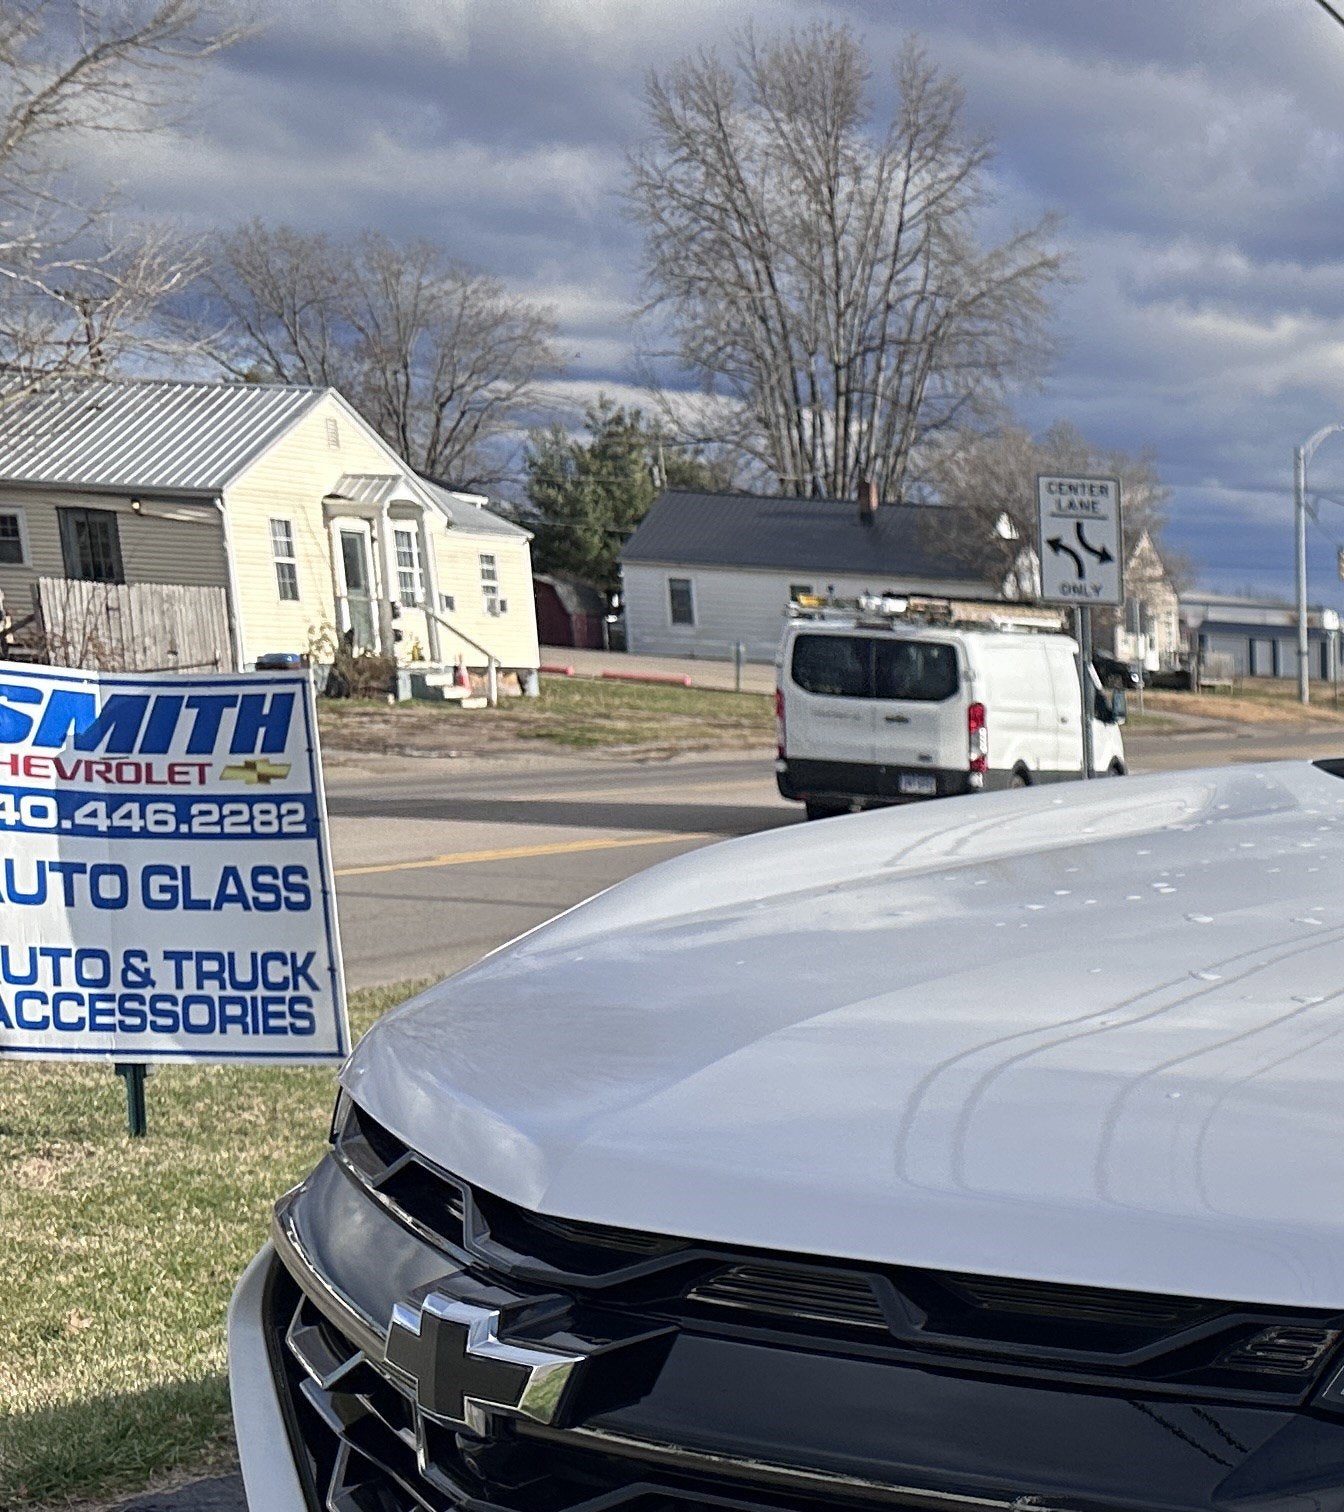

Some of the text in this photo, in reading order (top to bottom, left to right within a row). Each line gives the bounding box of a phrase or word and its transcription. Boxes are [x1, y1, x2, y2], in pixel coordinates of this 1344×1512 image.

[1046, 481, 1109, 497] CENTER
[1054, 498, 1098, 513] LANE
[1061, 582, 1103, 598] ONLY
[0, 684, 295, 754] SMITH
[0, 754, 213, 785] HEVROLET
[0, 794, 307, 834] 40.446.2282
[0, 858, 312, 912] UTO GLASS
[0, 945, 320, 991] UTO & TRUCK
